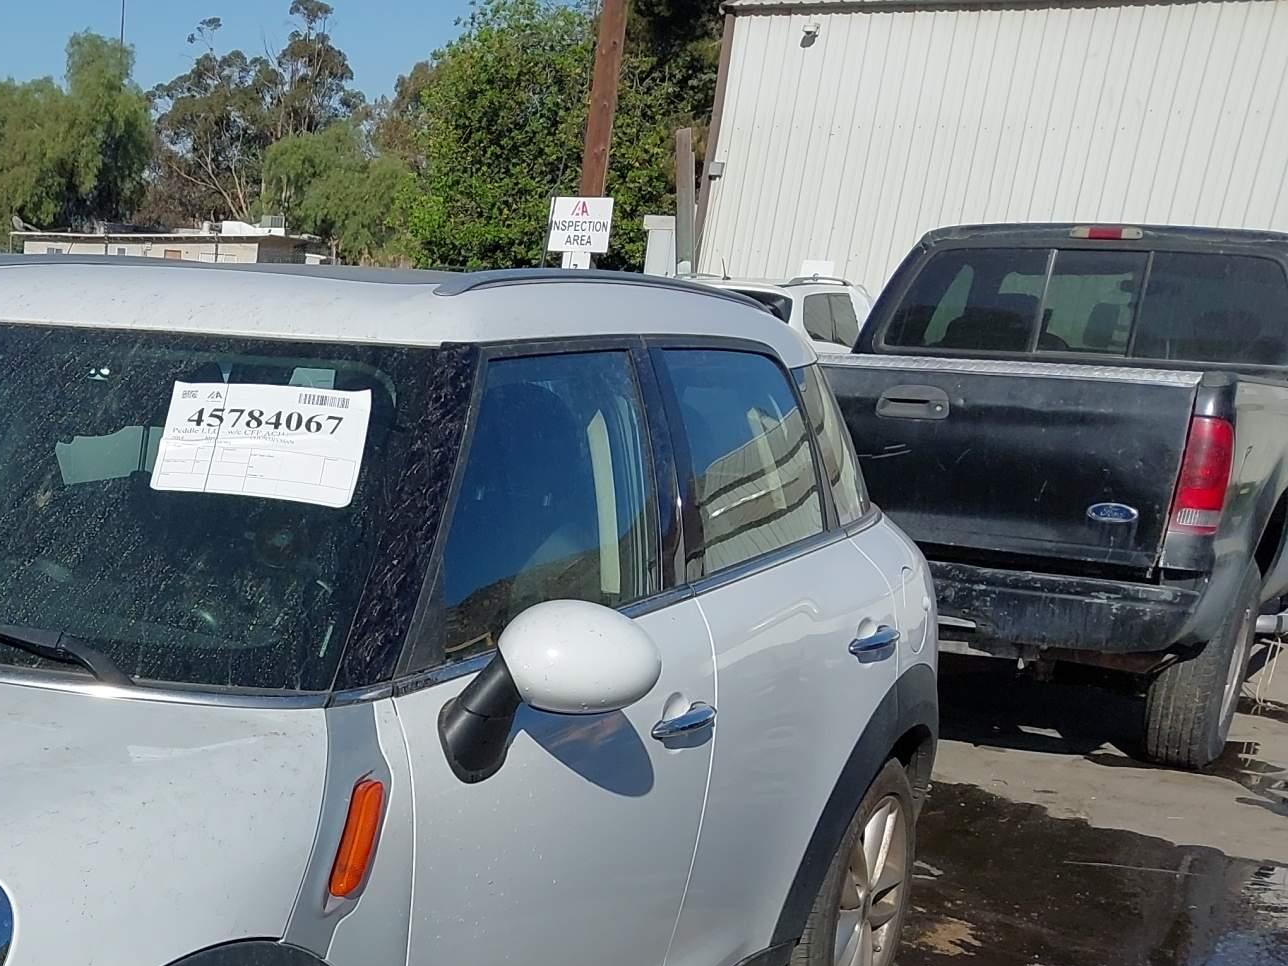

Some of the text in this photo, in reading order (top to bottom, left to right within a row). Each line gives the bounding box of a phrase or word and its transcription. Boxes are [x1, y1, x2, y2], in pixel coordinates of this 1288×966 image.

[550, 220, 609, 232] NSPECTION
[564, 234, 592, 246] AREA
[187, 407, 344, 435] 45784067
